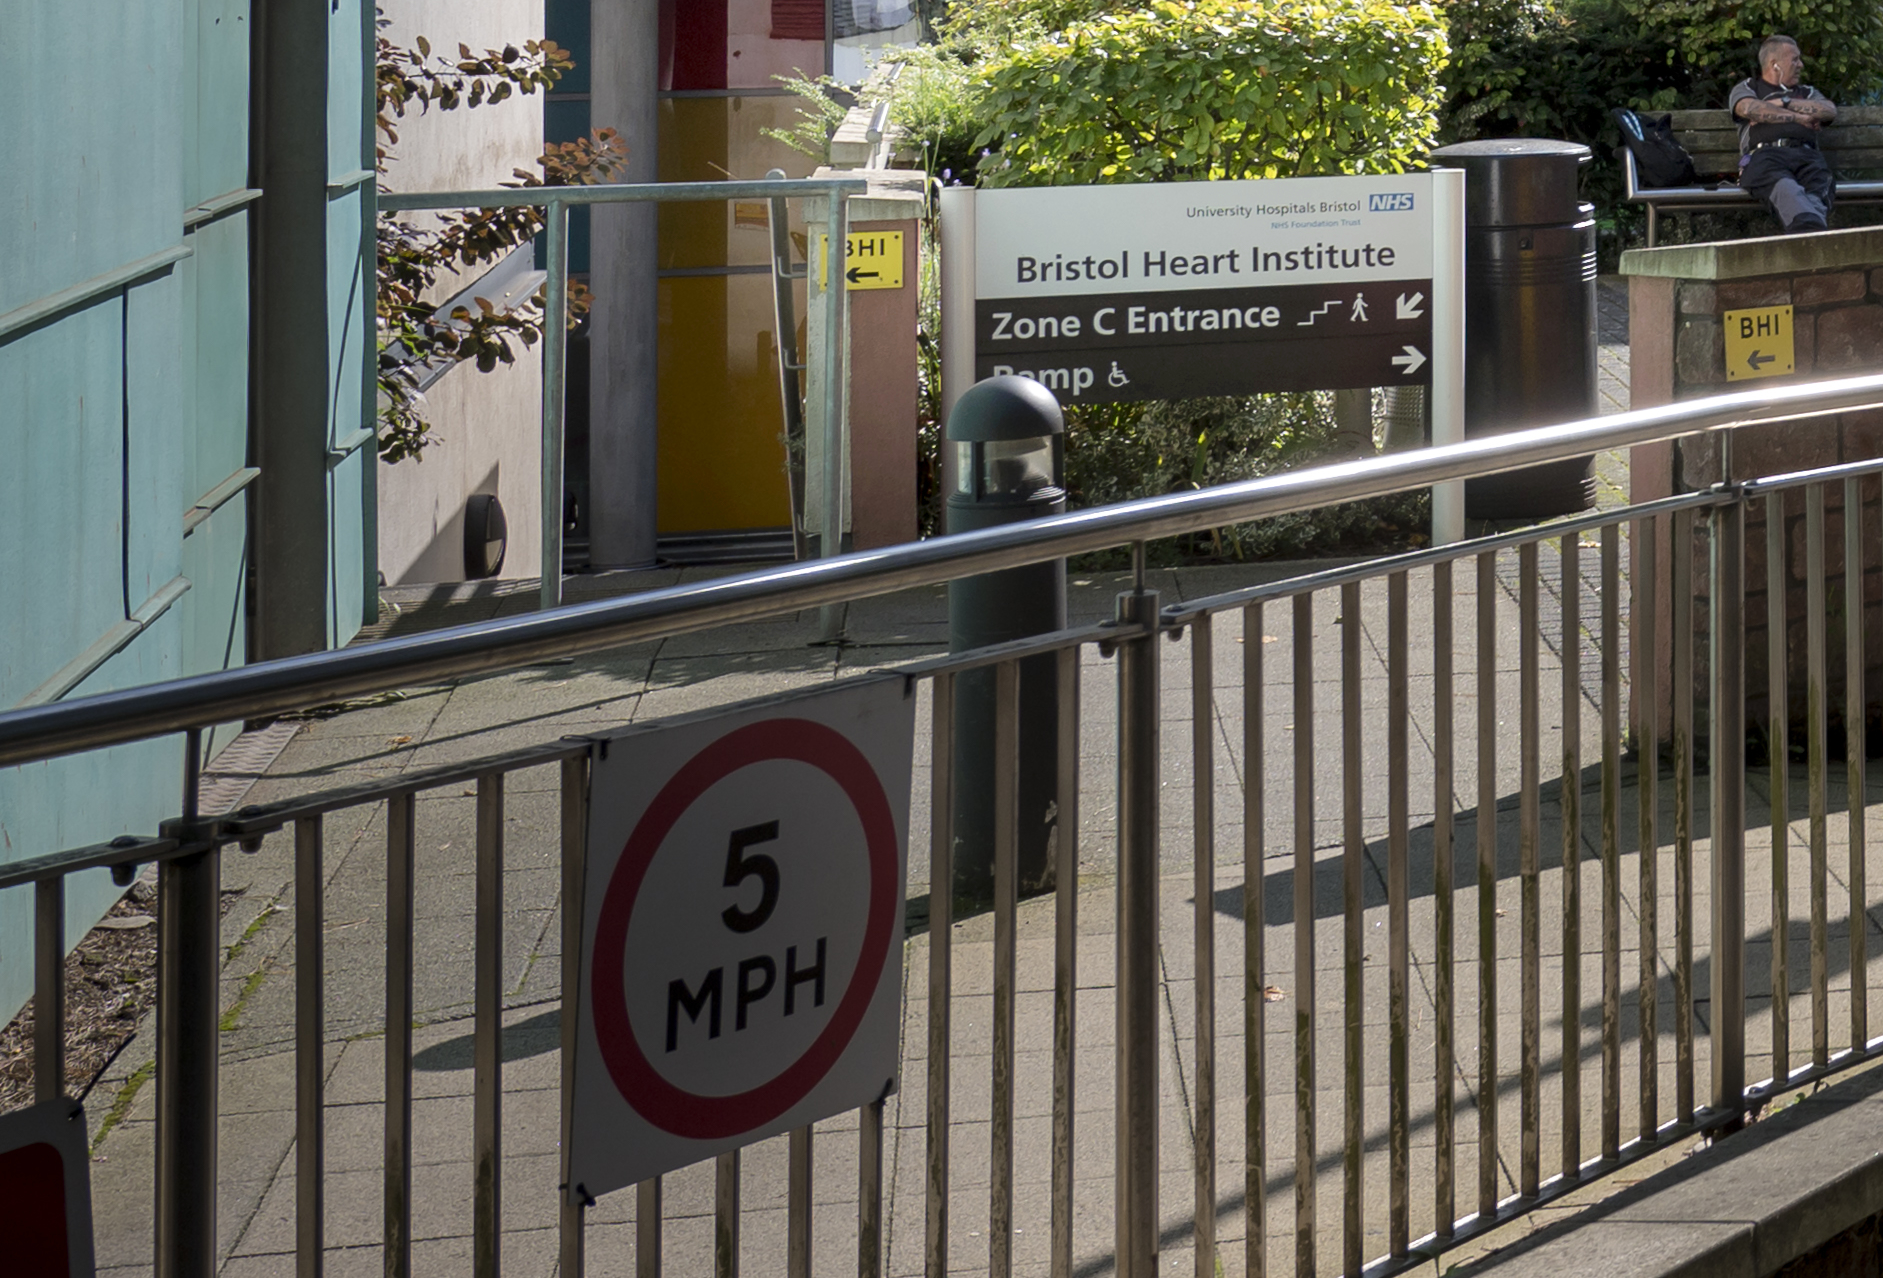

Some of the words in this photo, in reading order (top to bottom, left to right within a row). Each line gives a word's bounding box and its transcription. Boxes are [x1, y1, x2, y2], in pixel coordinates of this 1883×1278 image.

[1186, 205, 1252, 219] University
[1256, 202, 1316, 217] Hospitals
[1320, 200, 1361, 214] Bristol
[1370, 194, 1413, 211] NHS
[1271, 221, 1289, 230] NHS
[1291, 220, 1339, 229] Foundation
[1341, 218, 1361, 227] Trust
[1017, 250, 1129, 284] Bristol
[1143, 249, 1240, 278] Heart
[1252, 242, 1396, 273] Institute
[991, 311, 1081, 341] Zone
[1093, 308, 1116, 337] C
[1127, 304, 1281, 335] Entrance
[1740, 314, 1779, 339] BHI
[720, 819, 780, 934] 5
[665, 936, 827, 1054] MPH
